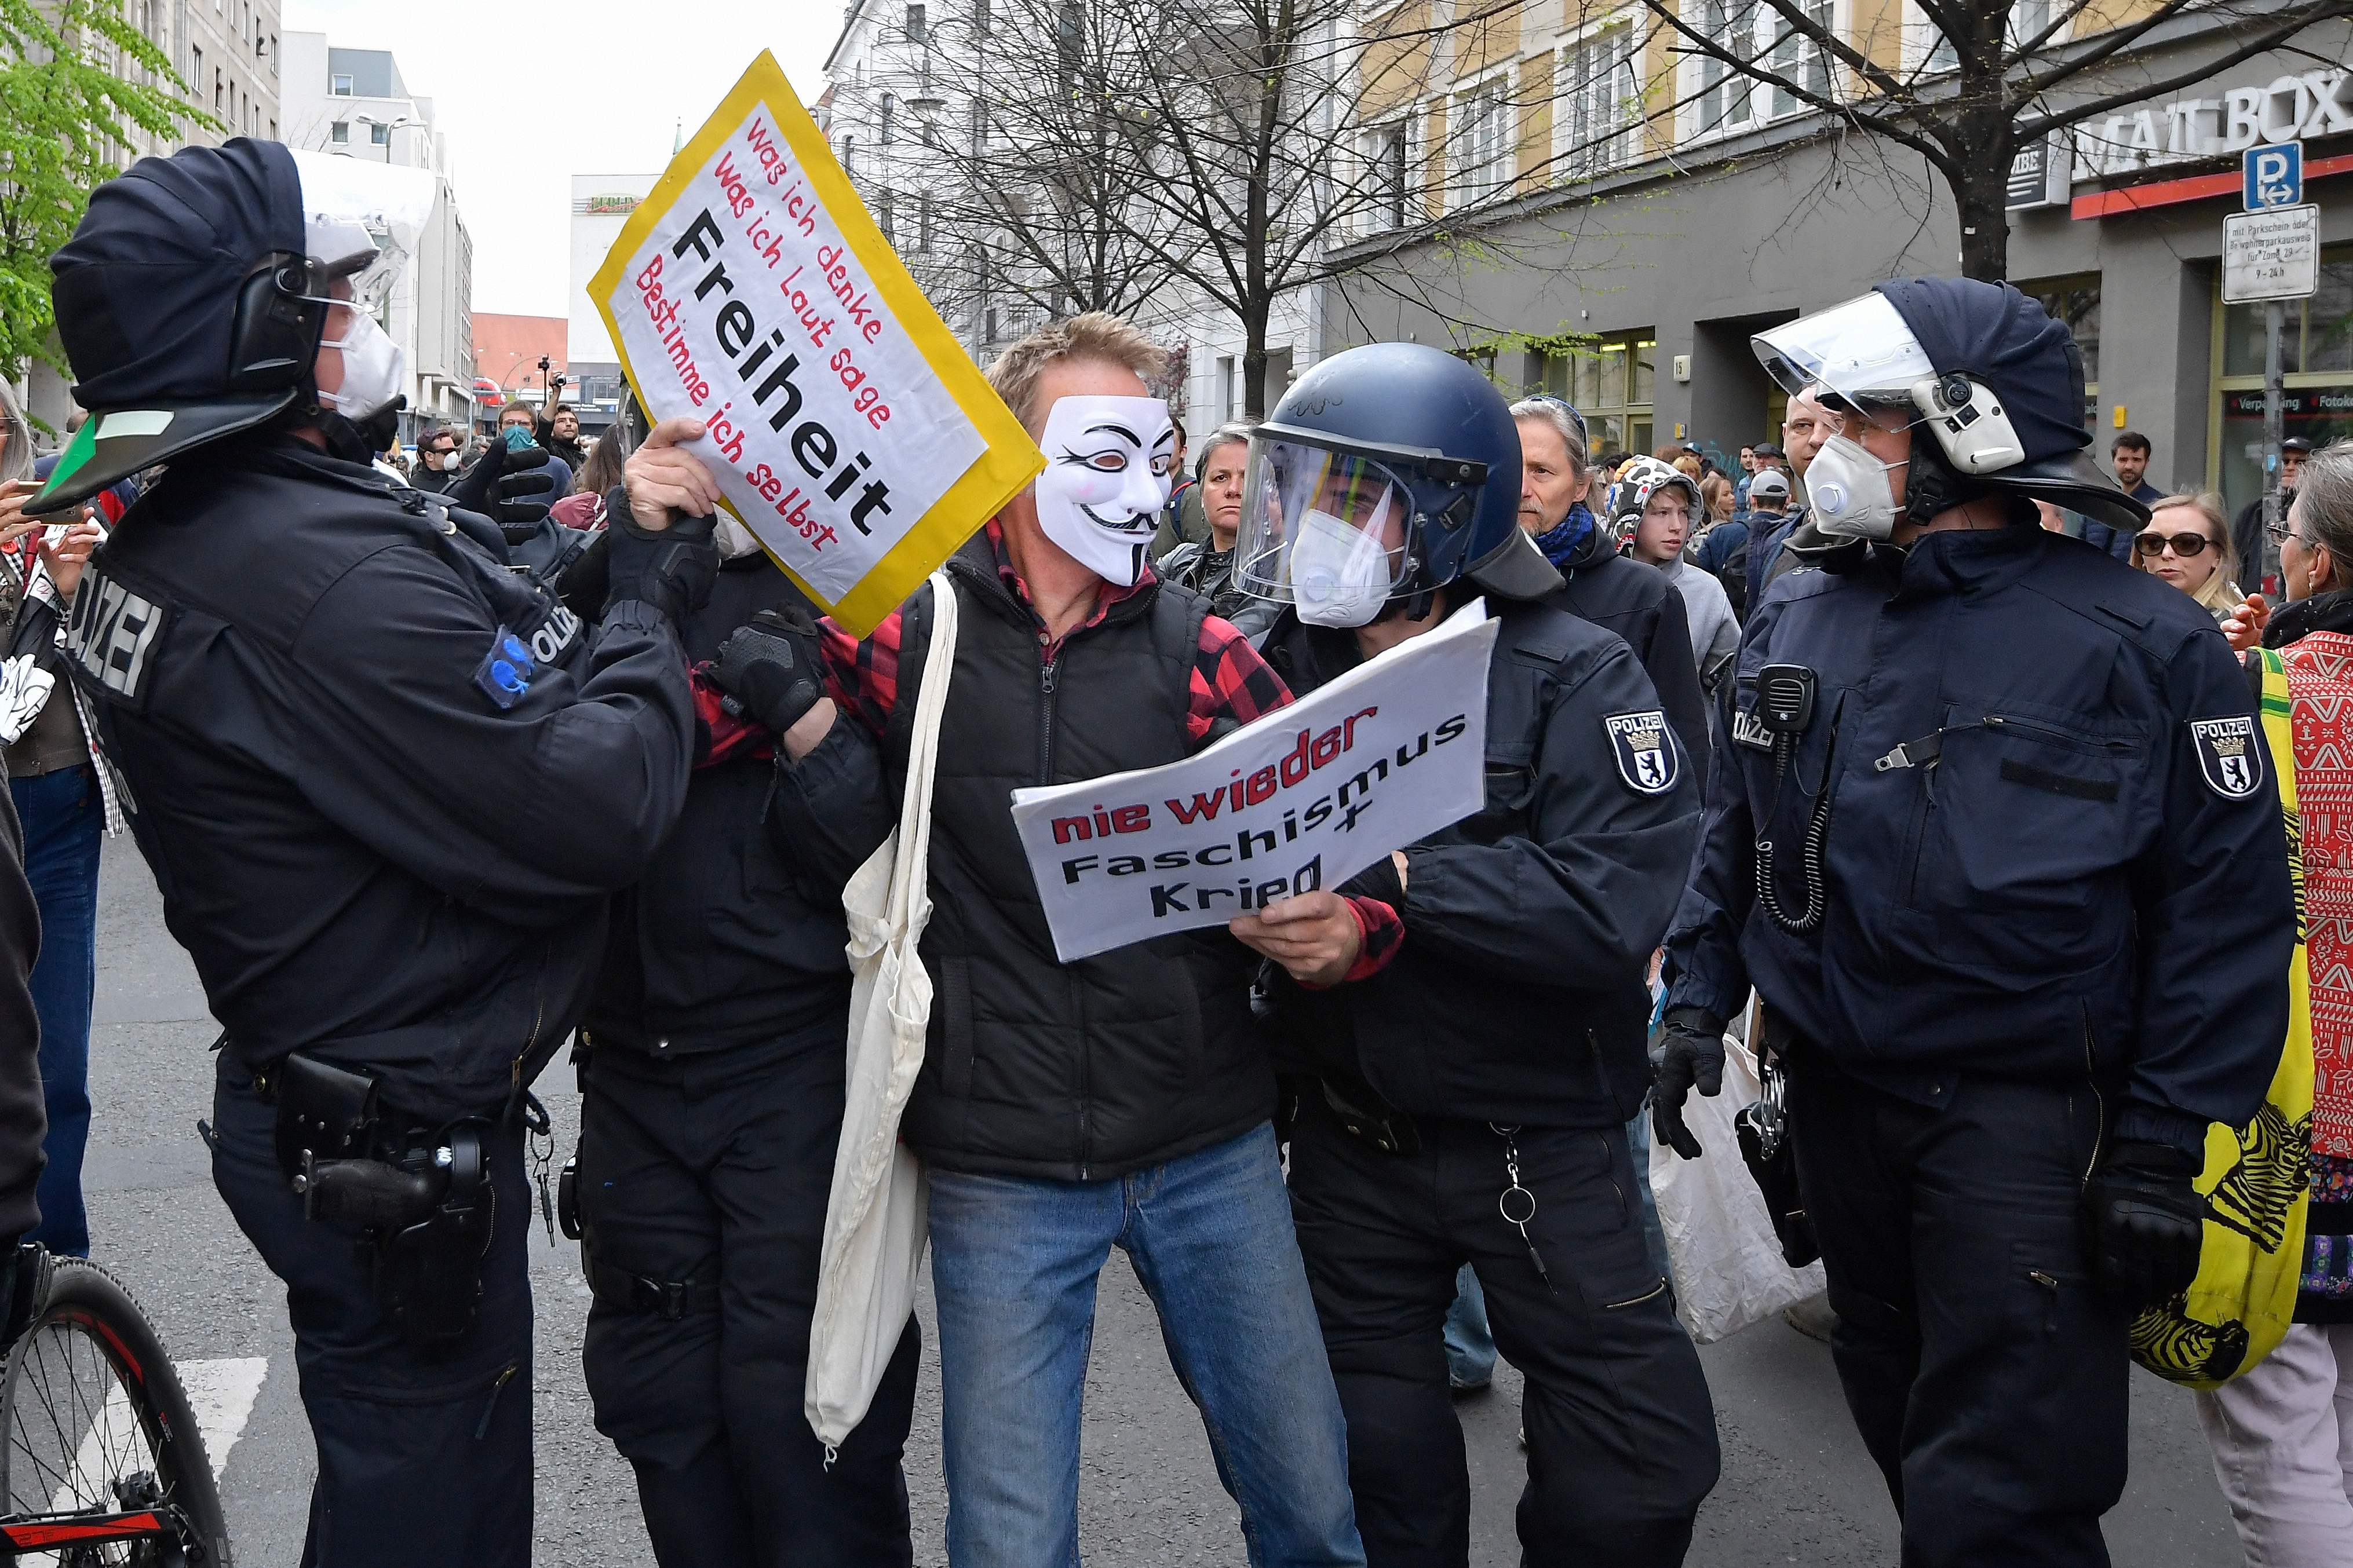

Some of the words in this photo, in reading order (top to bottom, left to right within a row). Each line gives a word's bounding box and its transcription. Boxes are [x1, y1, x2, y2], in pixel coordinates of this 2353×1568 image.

[747, 117, 786, 185] Was
[782, 180, 816, 237] ich
[817, 245, 881, 343] denke
[2232, 226, 2244, 236] mit
[2248, 222, 2289, 235] Parkschein
[2292, 219, 2309, 229] oder
[2256, 153, 2287, 201] P
[714, 151, 754, 219] Was
[746, 210, 783, 269] ich
[830, 348, 889, 430] sage
[2284, 247, 2293, 258] 29
[637, 253, 709, 406] Bestimme
[706, 403, 745, 463] ich
[746, 463, 838, 551] selbst
[673, 207, 892, 536] Freiheit
[1676, 362, 1682, 375] 15
[67, 560, 162, 697] OLIZEI
[1051, 803, 1151, 845] nie
[1165, 706, 1378, 827] wieder
[1611, 716, 1663, 735] POLIZEI
[2197, 721, 2250, 739] POLIZEI
[1061, 713, 1466, 884] Faschismus
